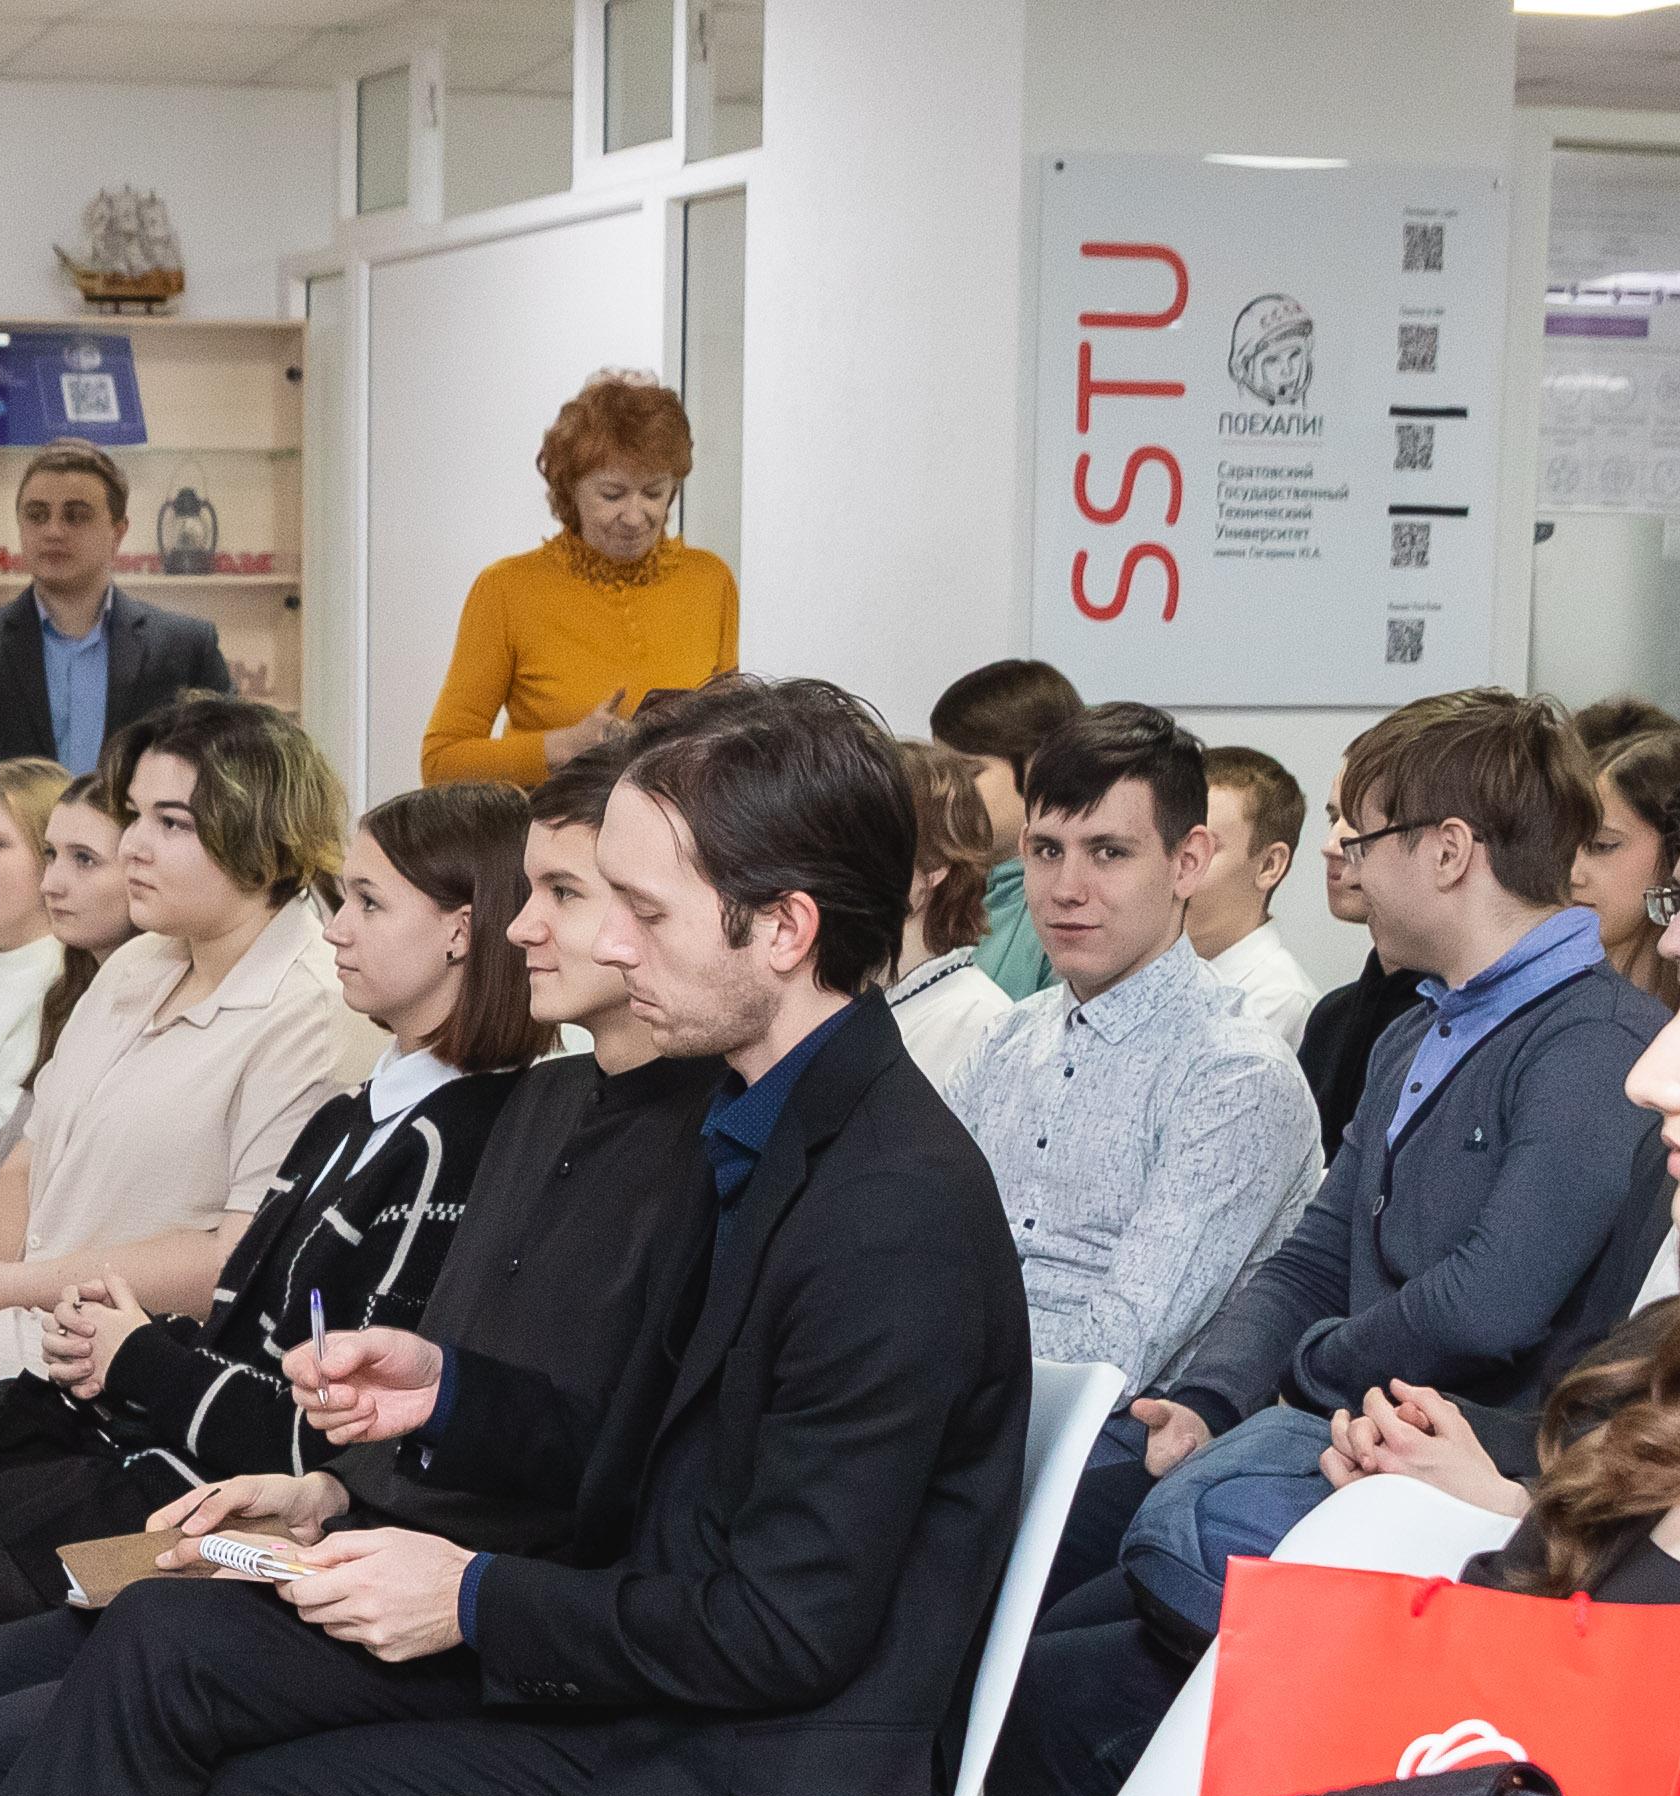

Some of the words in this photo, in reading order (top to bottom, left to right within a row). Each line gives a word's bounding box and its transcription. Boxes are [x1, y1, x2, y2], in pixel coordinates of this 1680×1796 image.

[1070, 241, 1190, 622] SSTU
[1218, 411, 1324, 437] ПОЕХАЛИ!
[1217, 460, 1314, 480] Саратовский
[1216, 480, 1350, 501] Государственный
[1218, 501, 1313, 519] Технический
[1215, 523, 1310, 542] Университет
